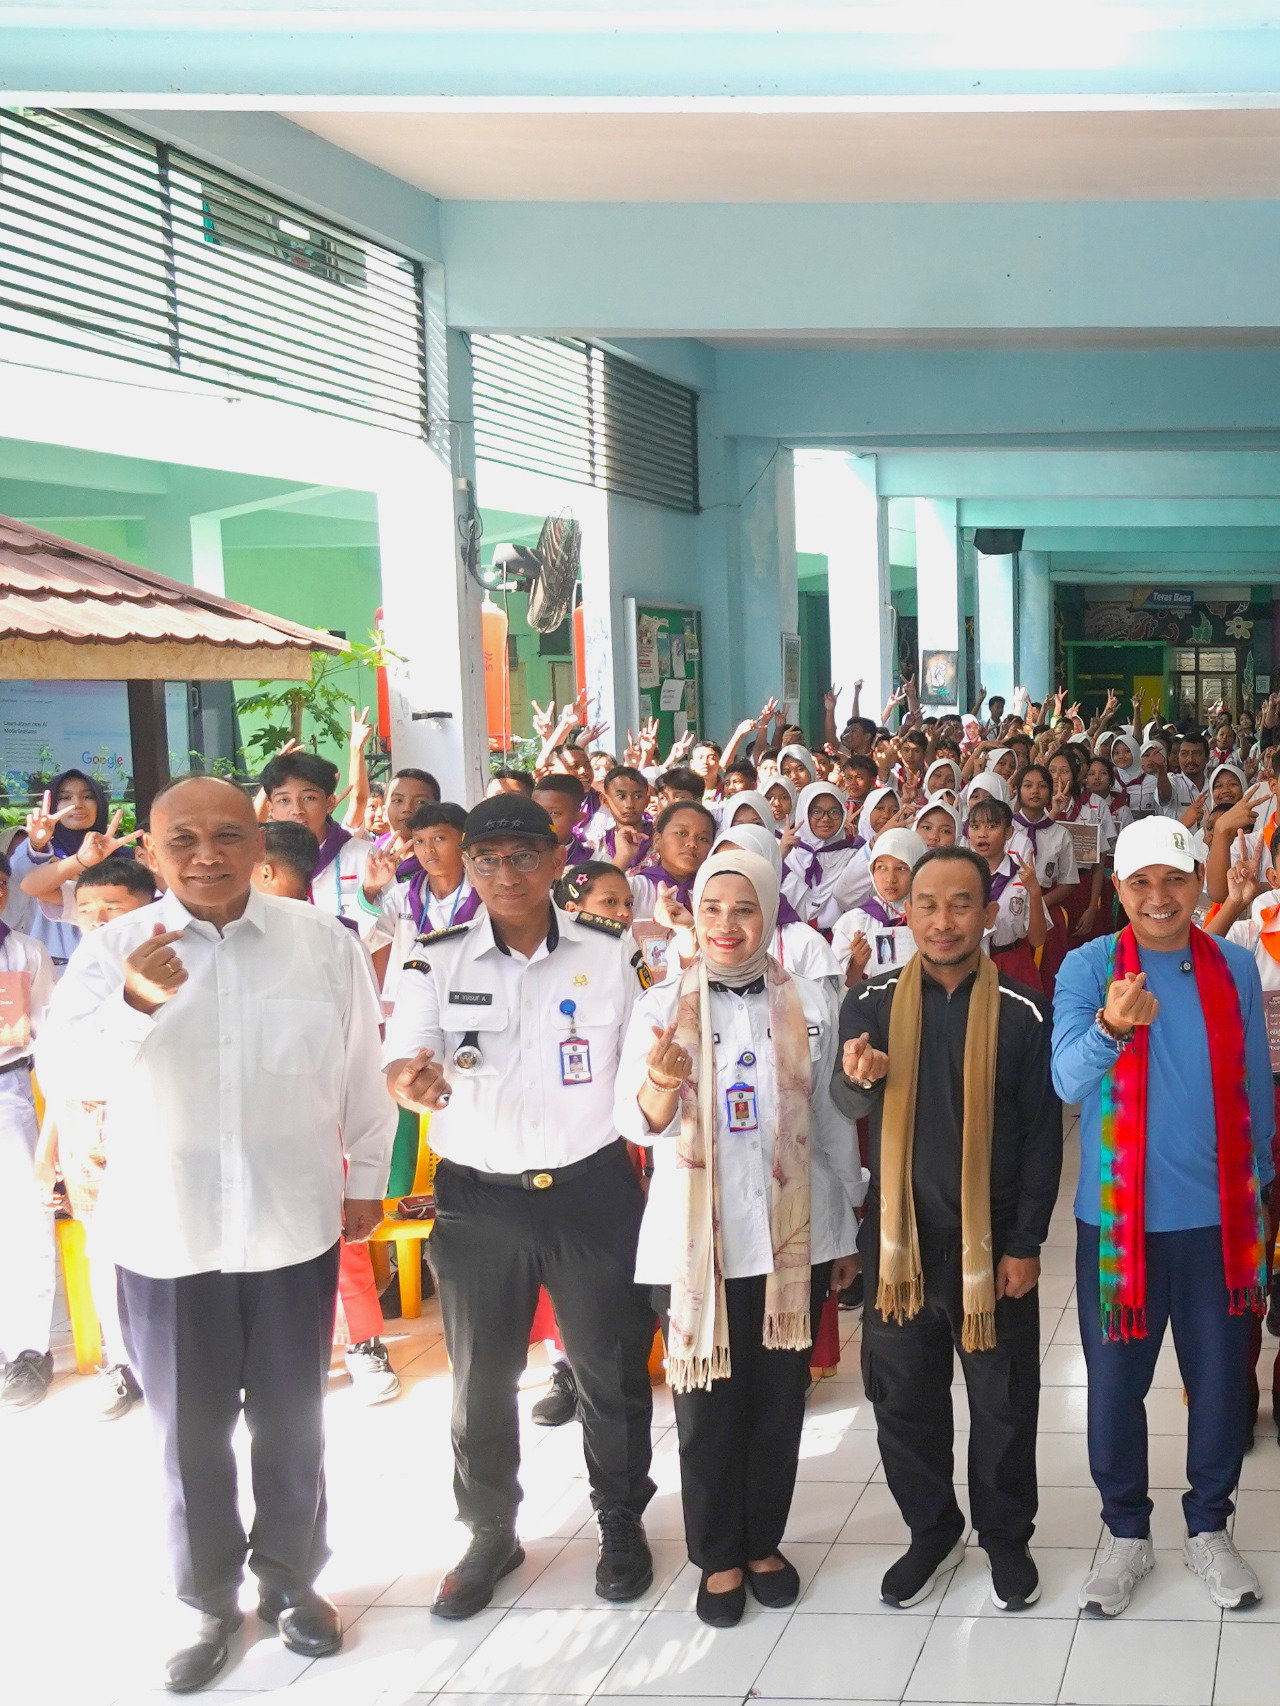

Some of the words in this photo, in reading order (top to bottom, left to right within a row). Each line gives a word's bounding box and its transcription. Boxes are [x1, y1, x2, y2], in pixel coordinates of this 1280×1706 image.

[1153, 592, 1172, 602] Teras
[1173, 593, 1192, 602] Baca
[82, 751, 123, 768] Google
